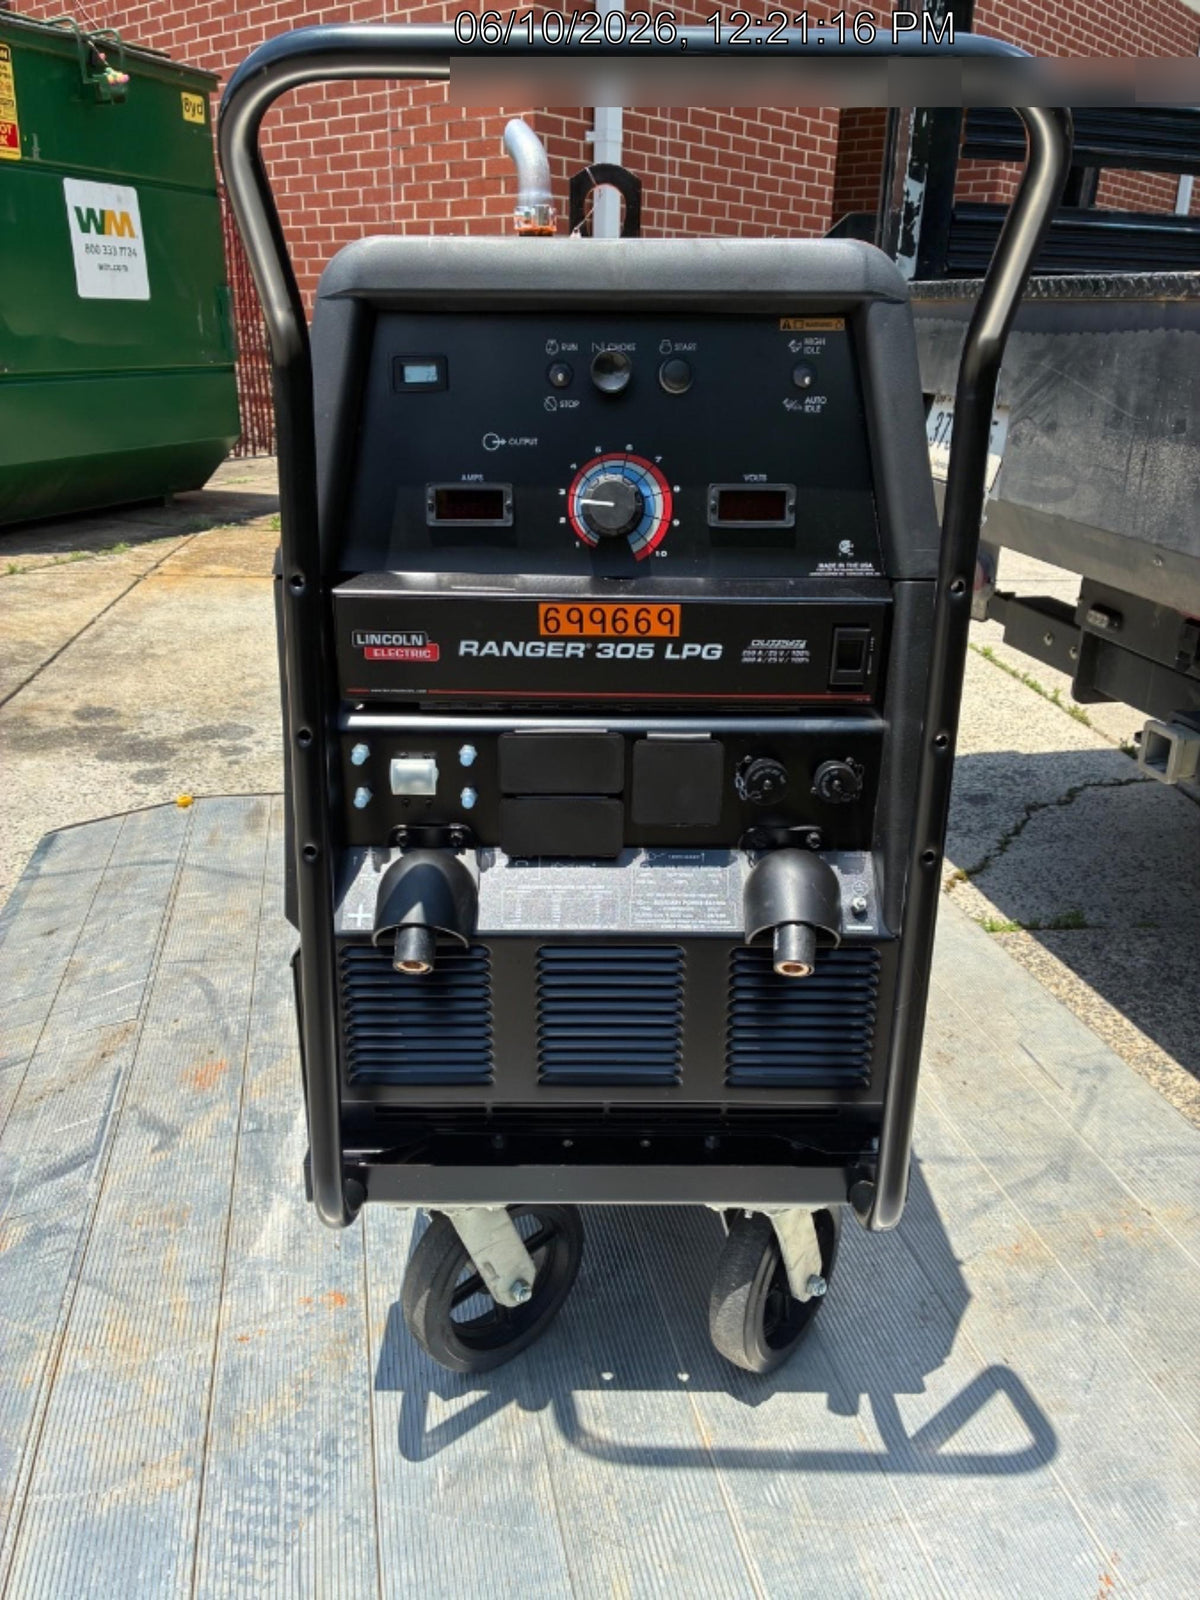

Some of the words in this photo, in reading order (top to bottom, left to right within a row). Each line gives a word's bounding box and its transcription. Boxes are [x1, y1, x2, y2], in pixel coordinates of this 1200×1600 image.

[74, 206, 136, 239] WM
[803, 337, 826, 346] HIGH
[561, 342, 579, 351] RUN
[674, 342, 698, 351] START
[803, 346, 821, 354] IDLE
[559, 400, 580, 409] STOP
[804, 396, 827, 405] AUTO
[804, 404, 821, 413] IDLE
[508, 437, 538, 446] OUTPUT
[743, 474, 767, 482] VOLTS
[543, 607, 675, 635] 699669
[356, 634, 424, 646] LINCOLN
[373, 649, 431, 659] ELECTRIC
[596, 643, 655, 659] 305
[665, 643, 723, 660] LPG
